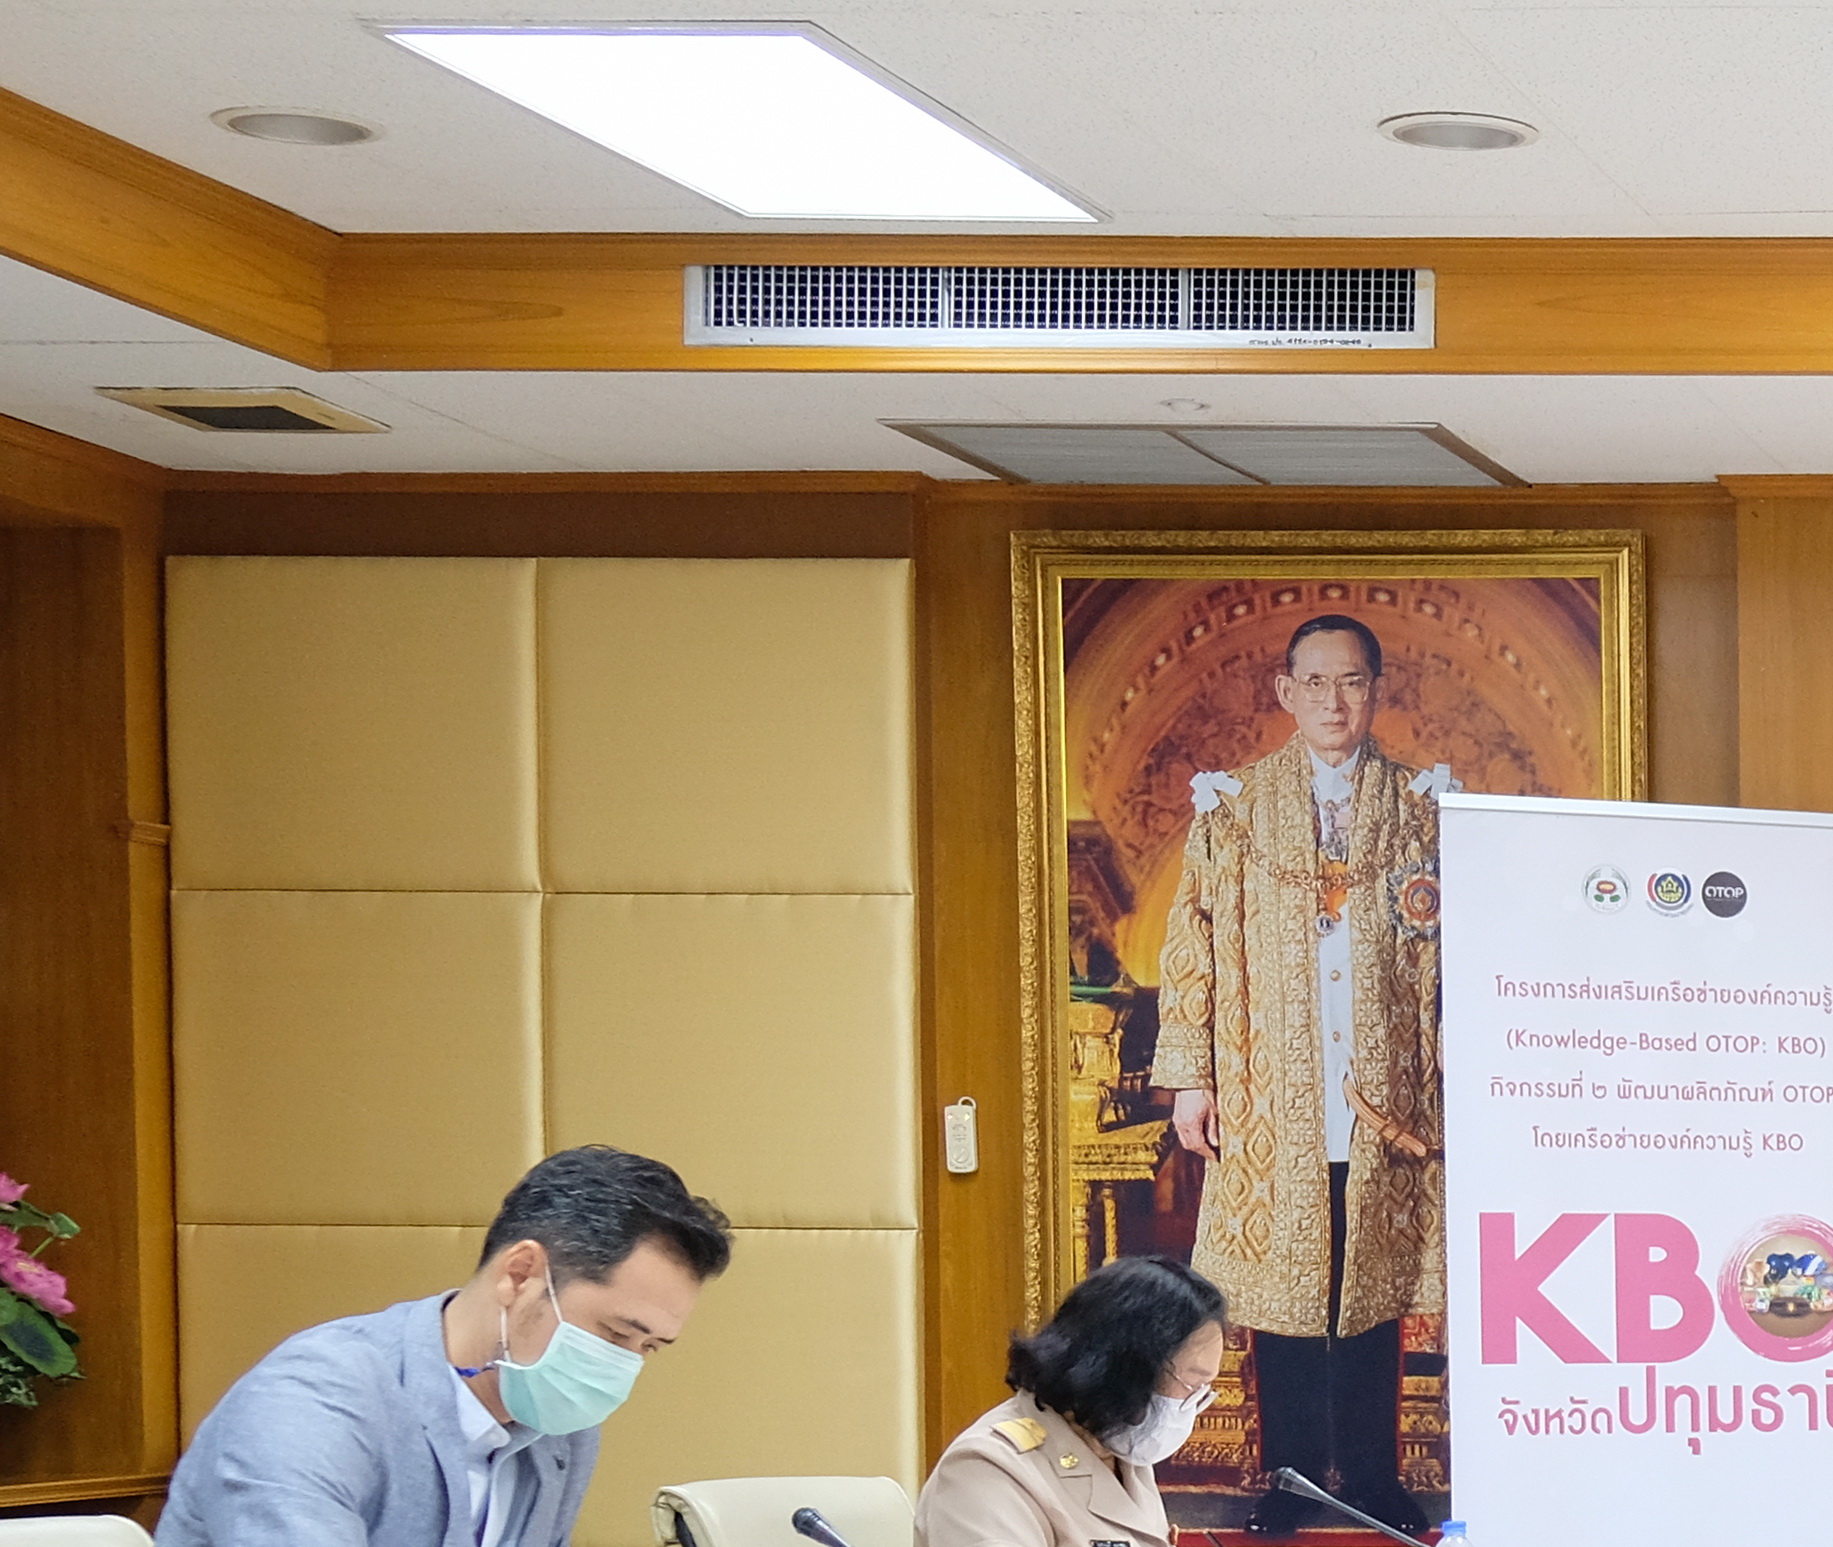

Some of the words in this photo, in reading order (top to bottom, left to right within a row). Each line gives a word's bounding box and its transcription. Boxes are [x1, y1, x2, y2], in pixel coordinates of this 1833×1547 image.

[1705, 885, 1744, 899] OTOP
[1495, 974, 1833, 1015] โครงการส่งเสริมเครือข่ายองค์ความรู้
[1506, 1028, 1697, 1057] (Knowledge-Based
[1705, 1034, 1767, 1054] OTOP:
[1777, 1036, 1826, 1058] KBO)
[1490, 1070, 1583, 1098] กิจกรรมที่
[1592, 1082, 1607, 1099] ๒
[1617, 1077, 1774, 1102] พัฒนาผลิตภัณฑ์
[1532, 1126, 1753, 1158] โดยเครือข่ายองค์ความรู้
[1762, 1133, 1804, 1152] KBO
